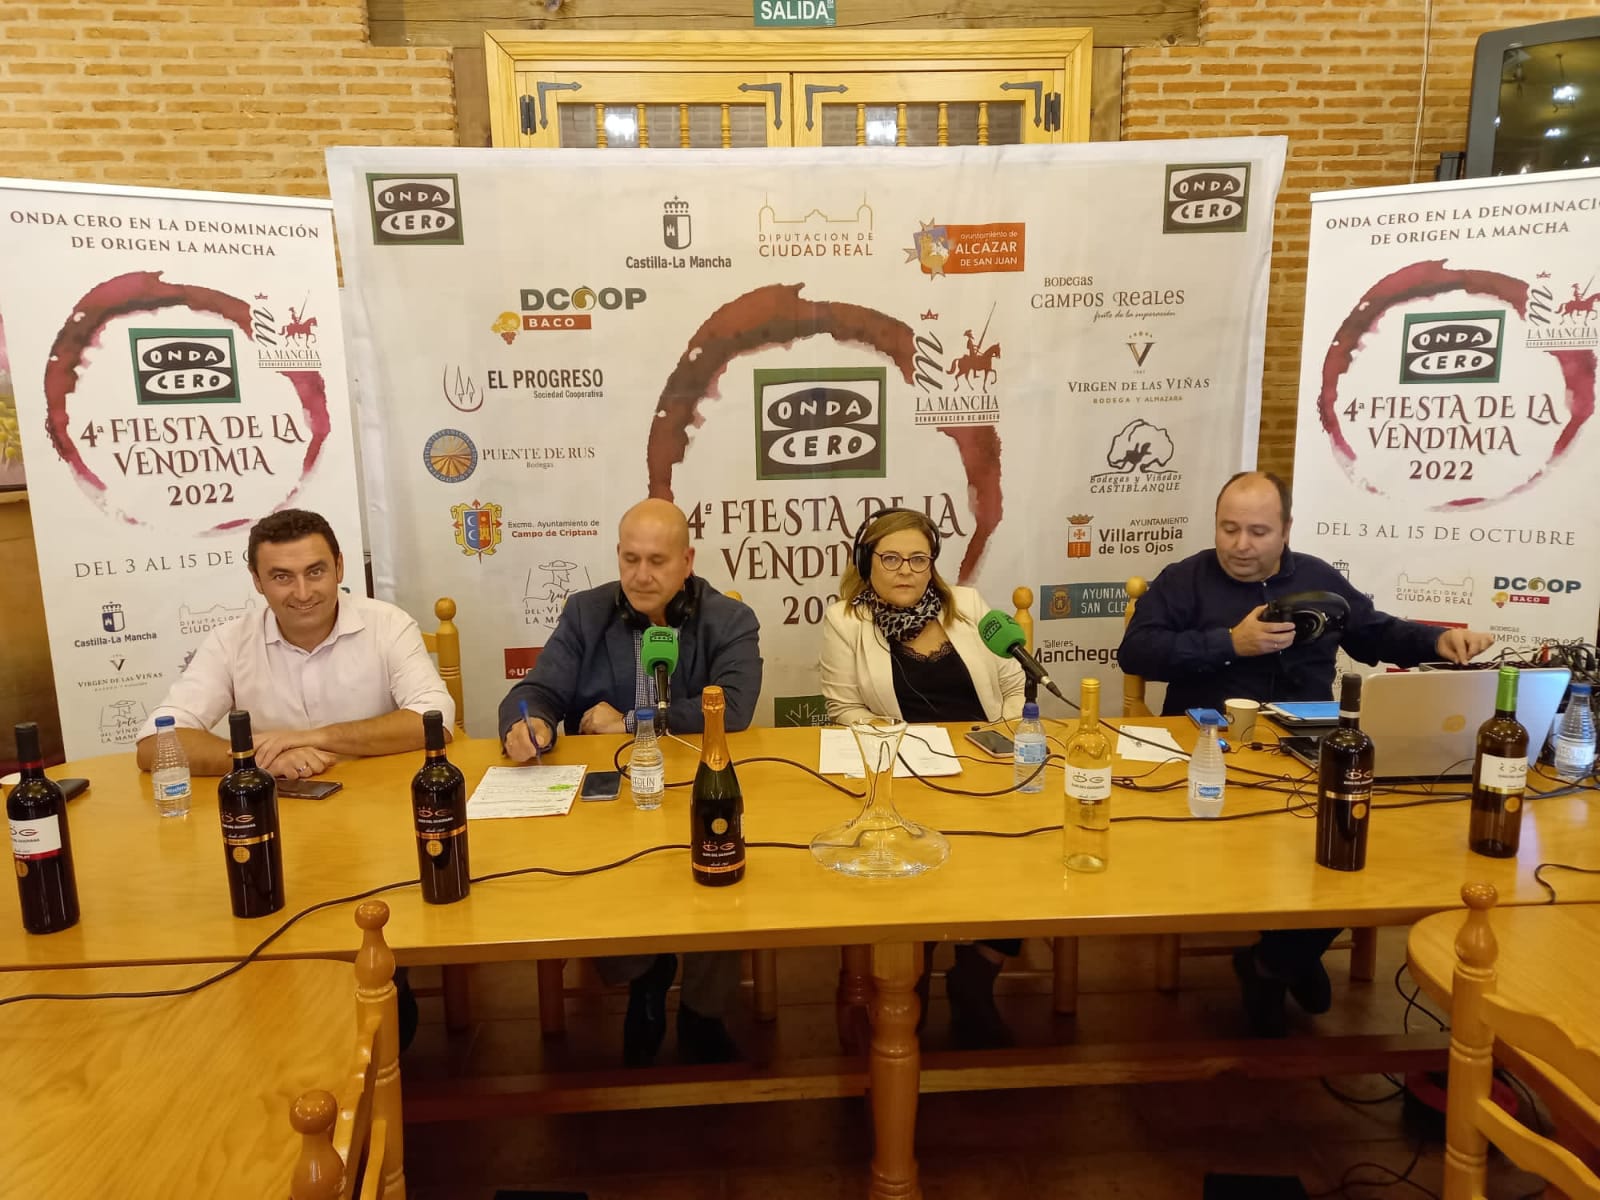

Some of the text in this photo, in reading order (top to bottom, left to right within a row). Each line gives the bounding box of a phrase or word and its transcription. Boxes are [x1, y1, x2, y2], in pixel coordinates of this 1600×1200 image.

[761, 1, 829, 20] SALIDA
[1180, 180, 1234, 219] ONDA CERO
[384, 191, 446, 230] ONDA CERO
[1326, 198, 1600, 230] ONDA CERO EN LA DENOMINACI
[10, 210, 319, 239] ONDA CERO EN LA DENOMINACIÓN
[1370, 221, 1570, 246] DE ORIGEN LA MANCHA
[857, 232, 873, 241] DE
[71, 236, 275, 257] DE ORIGEN LA MANCHA
[758, 244, 873, 257] CIUDAD REAL
[955, 239, 1017, 254] ALCÁZAR
[626, 256, 732, 269] Castilla-La Mancha
[961, 256, 1018, 266] DE SAN JUAN
[519, 285, 647, 311] DCOOP
[528, 318, 575, 328] BACO
[275, 349, 320, 359] MANCHA
[1419, 332, 1485, 370] ONDA CERO
[150, 350, 221, 390] ONDA CERO
[488, 368, 604, 390] EL PROGRESO
[1068, 377, 1210, 392] VIRGEN DE LAS VIÑAS
[533, 390, 604, 399] Sociedad Cooperativa
[916, 395, 999, 411] LA MANCHA
[1370, 394, 1472, 425] FIESTA
[1474, 395, 1516, 419] DE
[1527, 394, 1562, 425] LA
[110, 415, 222, 445] FIESTA
[221, 415, 264, 439] DE
[272, 413, 306, 443] LA
[777, 400, 863, 458] ONDA CERO
[1368, 419, 1521, 456] VENDIMIA
[113, 445, 276, 477] VENDIMIA
[482, 447, 595, 461] PUENTE DE RUS
[1409, 460, 1473, 480] 2022
[1090, 475, 1129, 484] Bodegas
[1134, 475, 1141, 484] y
[1090, 482, 1181, 494] CASTIBLANQUE
[168, 483, 234, 506] 2022
[507, 519, 600, 529] Excmo. Ayuntamiento de
[720, 496, 854, 539] FIESTA
[1130, 517, 1189, 527] AYUNTAMIENTO
[511, 529, 598, 539] Campo de Criptana
[1098, 526, 1183, 542] Villarrubia
[1316, 522, 1576, 546] DEL 3 AL 15 DE OCTUBRE
[1098, 542, 1174, 555] de los Ojos
[74, 561, 117, 578] DEL
[126, 558, 137, 573] 3
[145, 555, 171, 571] AL
[180, 554, 197, 568] 15
[207, 551, 234, 566] DE
[720, 536, 853, 586] VENDI
[1082, 588, 1129, 600] AYUNTAM
[1494, 576, 1582, 594] DCOOP
[1081, 602, 1100, 614] SAN
[1396, 593, 1473, 605] CIUDAD REAL
[784, 595, 839, 625] 20
[74, 632, 157, 648] Castilla-La Mancha
[1043, 639, 1074, 649] Talleres
